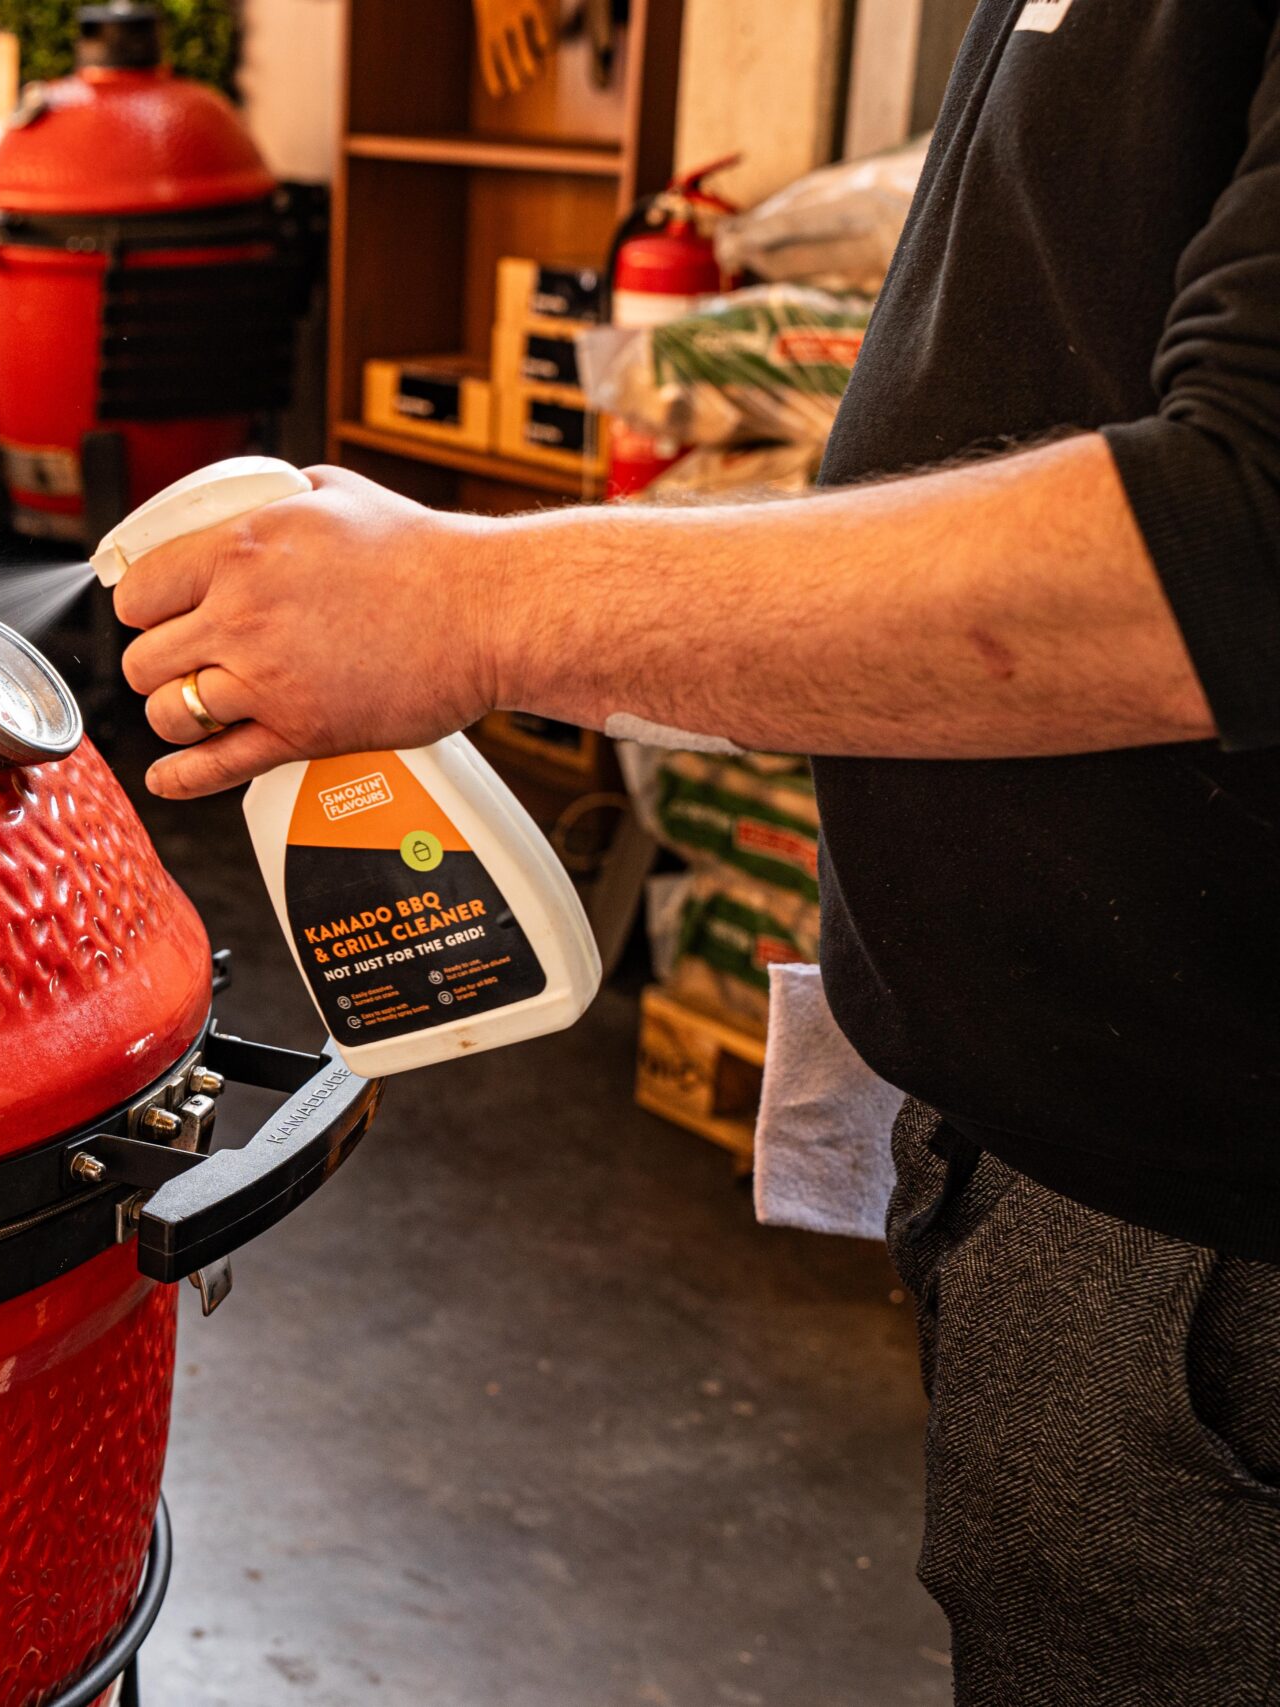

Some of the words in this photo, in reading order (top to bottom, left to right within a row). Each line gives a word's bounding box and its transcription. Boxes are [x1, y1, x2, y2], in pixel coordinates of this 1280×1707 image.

[330, 790, 385, 816] FLAVOURS
[304, 906, 392, 943] KAMADO
[396, 891, 441, 918] BBQ
[314, 948, 330, 963] &
[332, 931, 390, 958] GRILL
[391, 899, 487, 941] CLEANER
[324, 966, 351, 981] NOT
[354, 957, 384, 974] JUST
[386, 948, 415, 964] FOR
[415, 939, 443, 956] THE
[445, 925, 486, 946] GRID!
